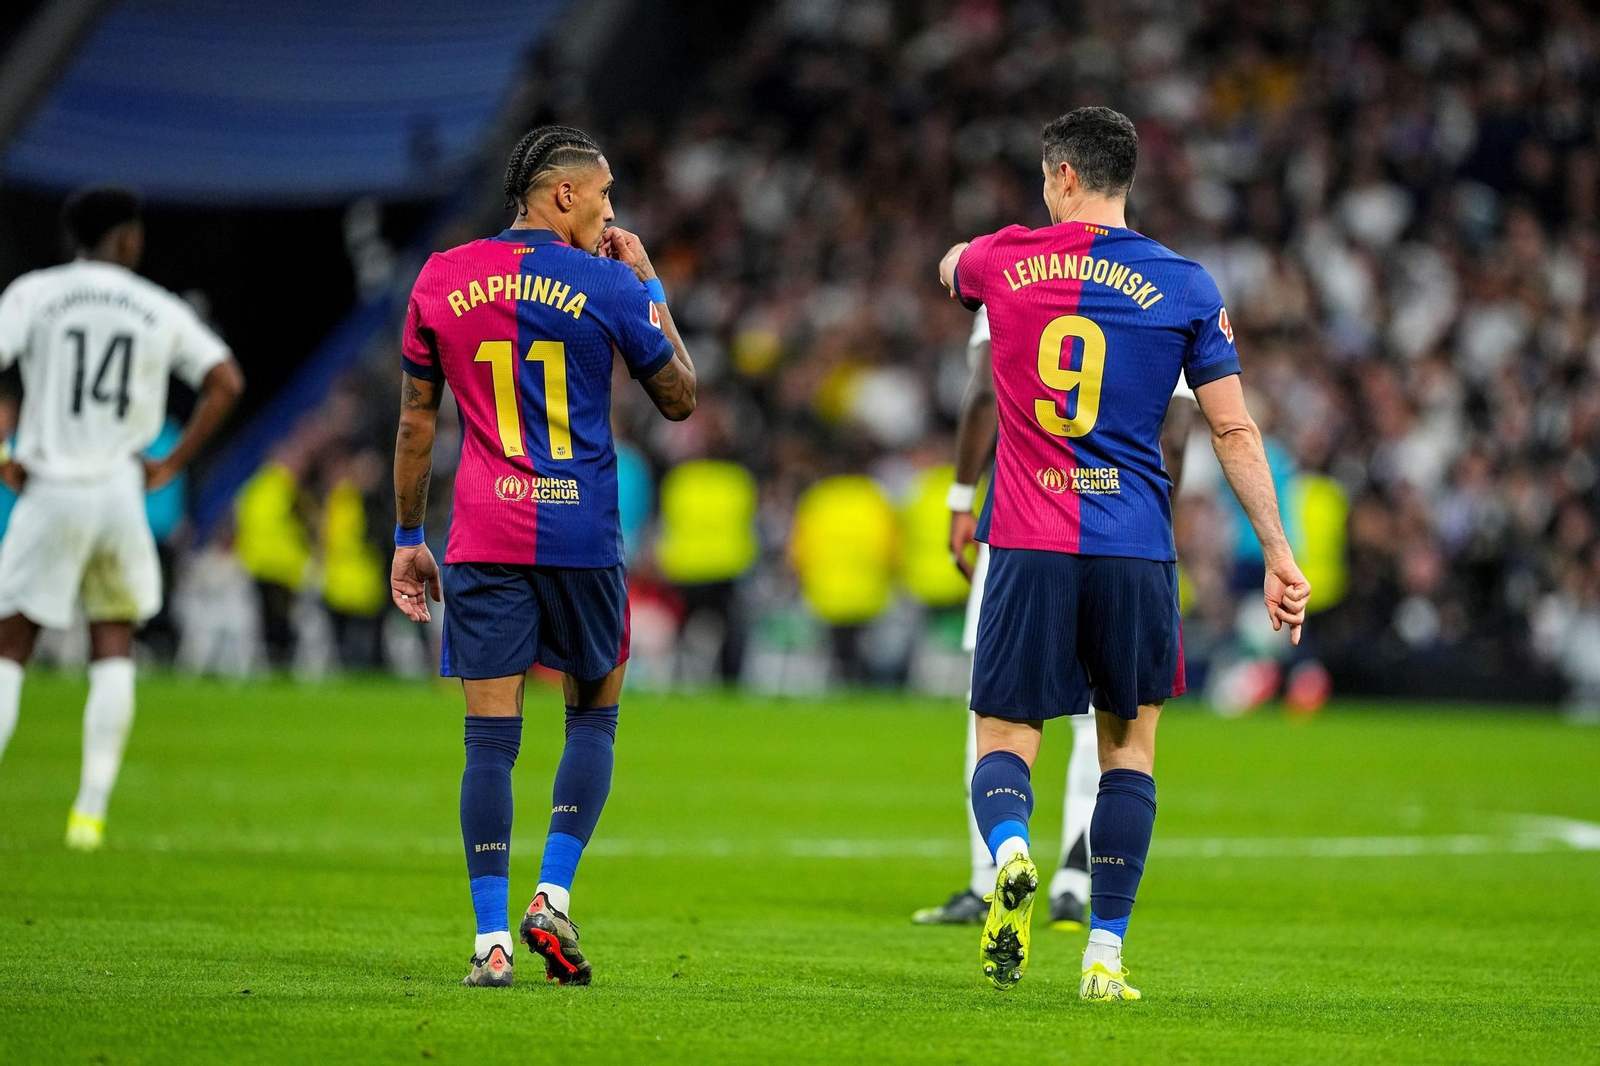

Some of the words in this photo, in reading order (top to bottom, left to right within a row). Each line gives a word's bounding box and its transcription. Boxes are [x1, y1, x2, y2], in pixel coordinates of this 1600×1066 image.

[447, 274, 587, 319] RAPHINHA
[1003, 253, 1163, 310] LEWANDOWSKI
[65, 328, 134, 418] 14
[1034, 314, 1107, 438] 9
[473, 340, 573, 460] 11
[530, 488, 580, 500] ACNUR
[531, 477, 578, 489] UNHCR
[1070, 467, 1119, 479] UNHCR
[1071, 478, 1120, 490] ACNUR
